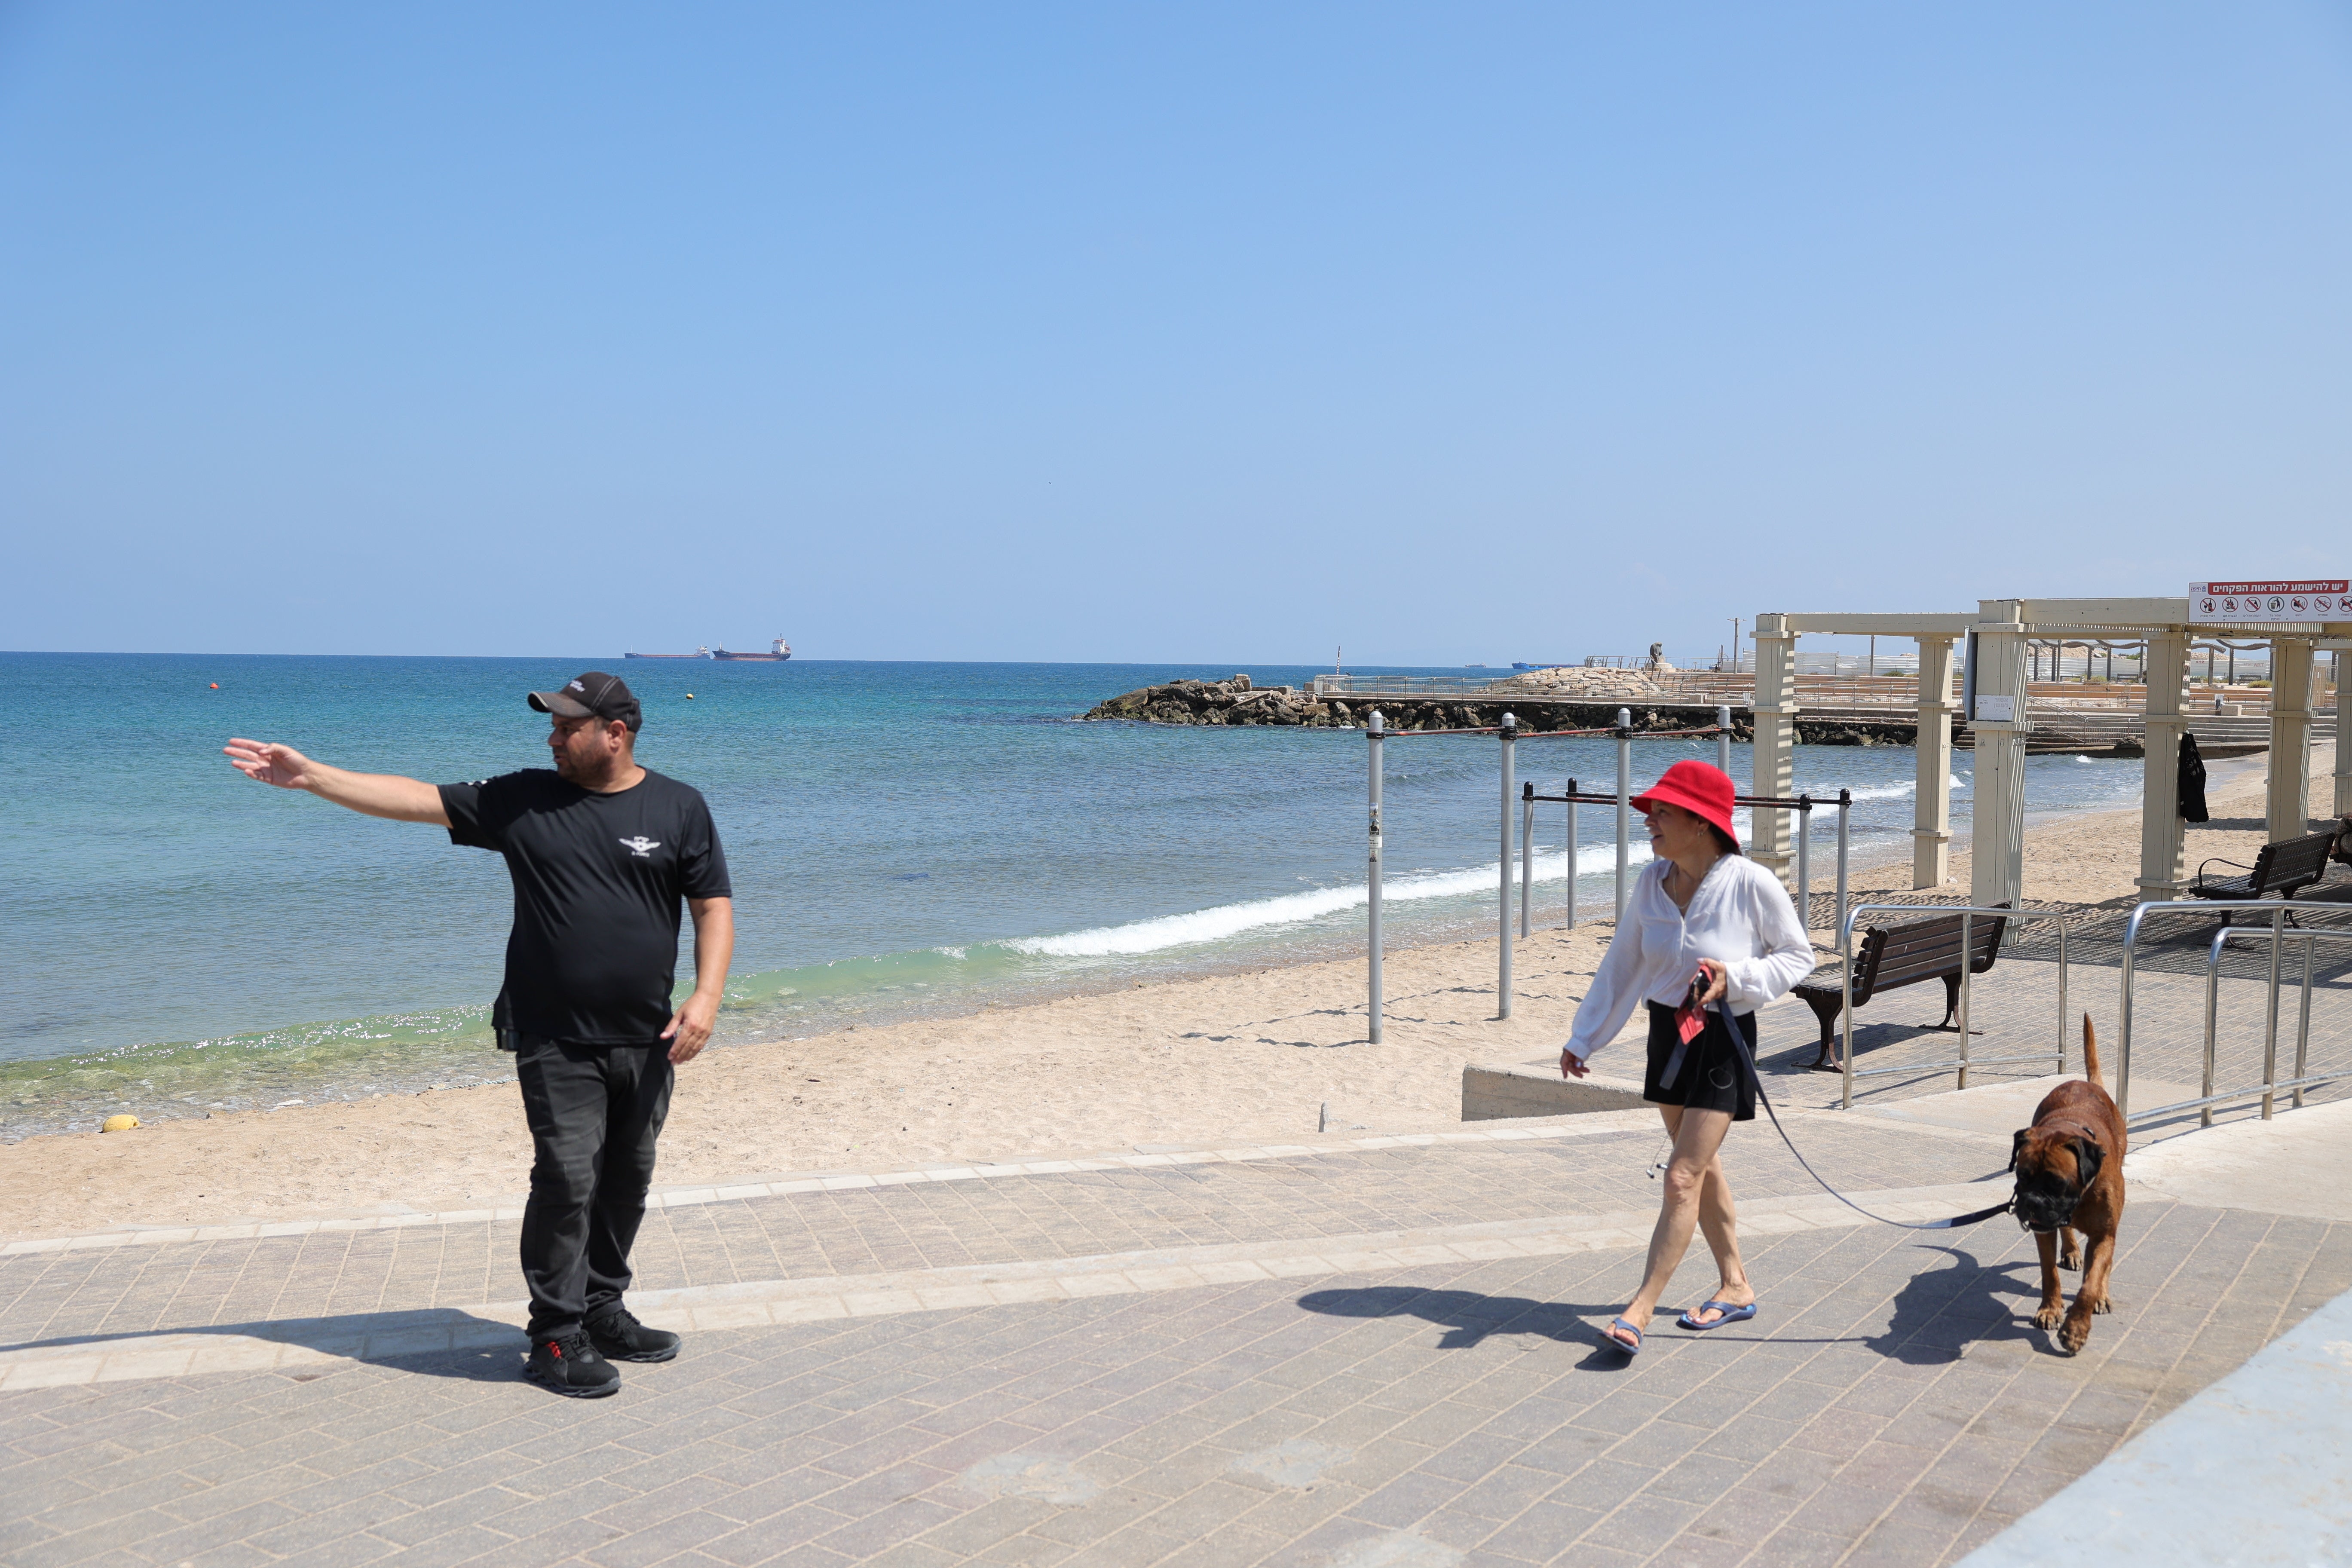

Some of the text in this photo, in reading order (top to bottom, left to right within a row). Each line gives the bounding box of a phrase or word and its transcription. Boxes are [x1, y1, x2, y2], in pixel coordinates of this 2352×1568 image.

[2213, 585, 2248, 594] הפקחים
[2250, 583, 2288, 591] להוראות
[2291, 582, 2329, 591] להישמע
